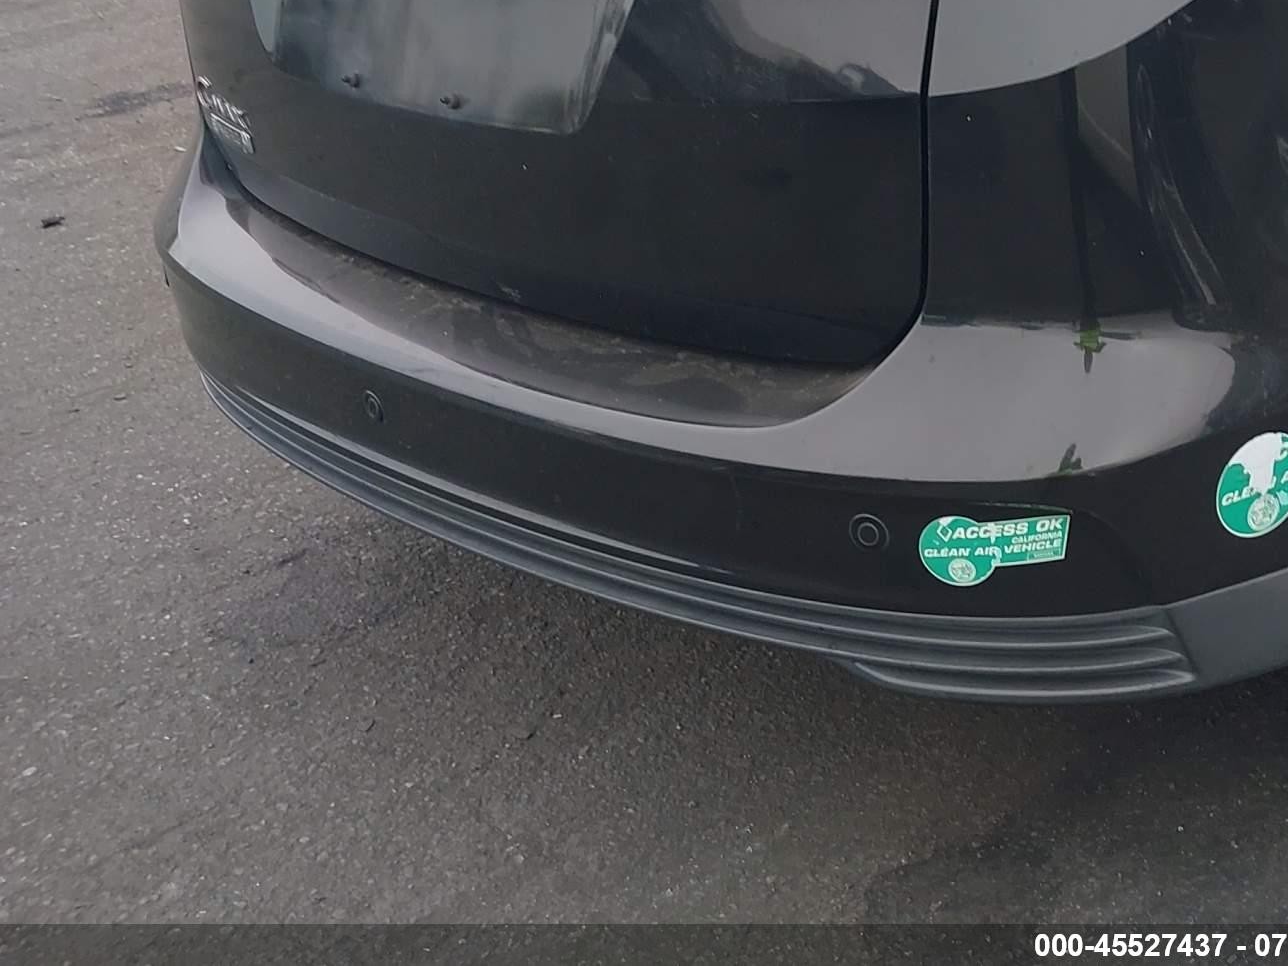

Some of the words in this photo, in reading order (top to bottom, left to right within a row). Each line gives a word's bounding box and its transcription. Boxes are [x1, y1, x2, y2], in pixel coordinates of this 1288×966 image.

[952, 522, 1029, 540] ACCESS
[1036, 518, 1065, 532] OK
[1011, 530, 1063, 545] CALIFORNIA
[924, 547, 970, 558] CLEAN
[974, 545, 1000, 557] AIR
[1004, 538, 1062, 555] VEHICLE
